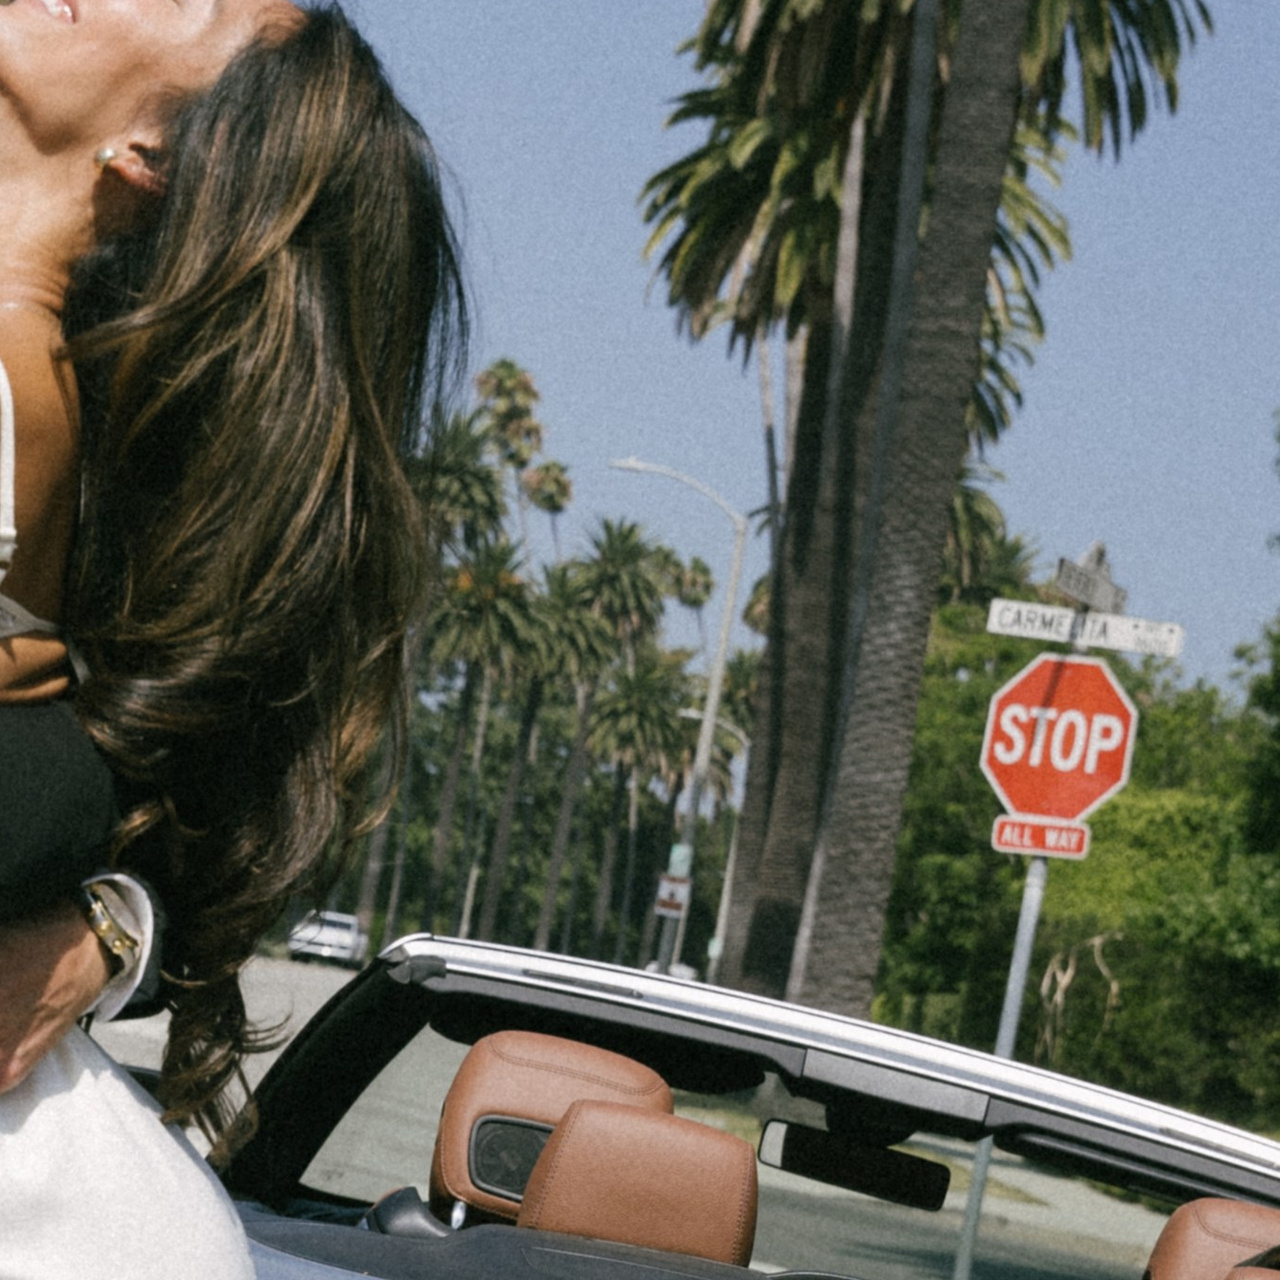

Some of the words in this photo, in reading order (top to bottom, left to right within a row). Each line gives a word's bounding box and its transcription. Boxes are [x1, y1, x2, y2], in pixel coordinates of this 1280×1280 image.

[993, 703, 1125, 775] STOP
[1000, 824, 1034, 848] ALL
[1043, 827, 1082, 850] WAY
